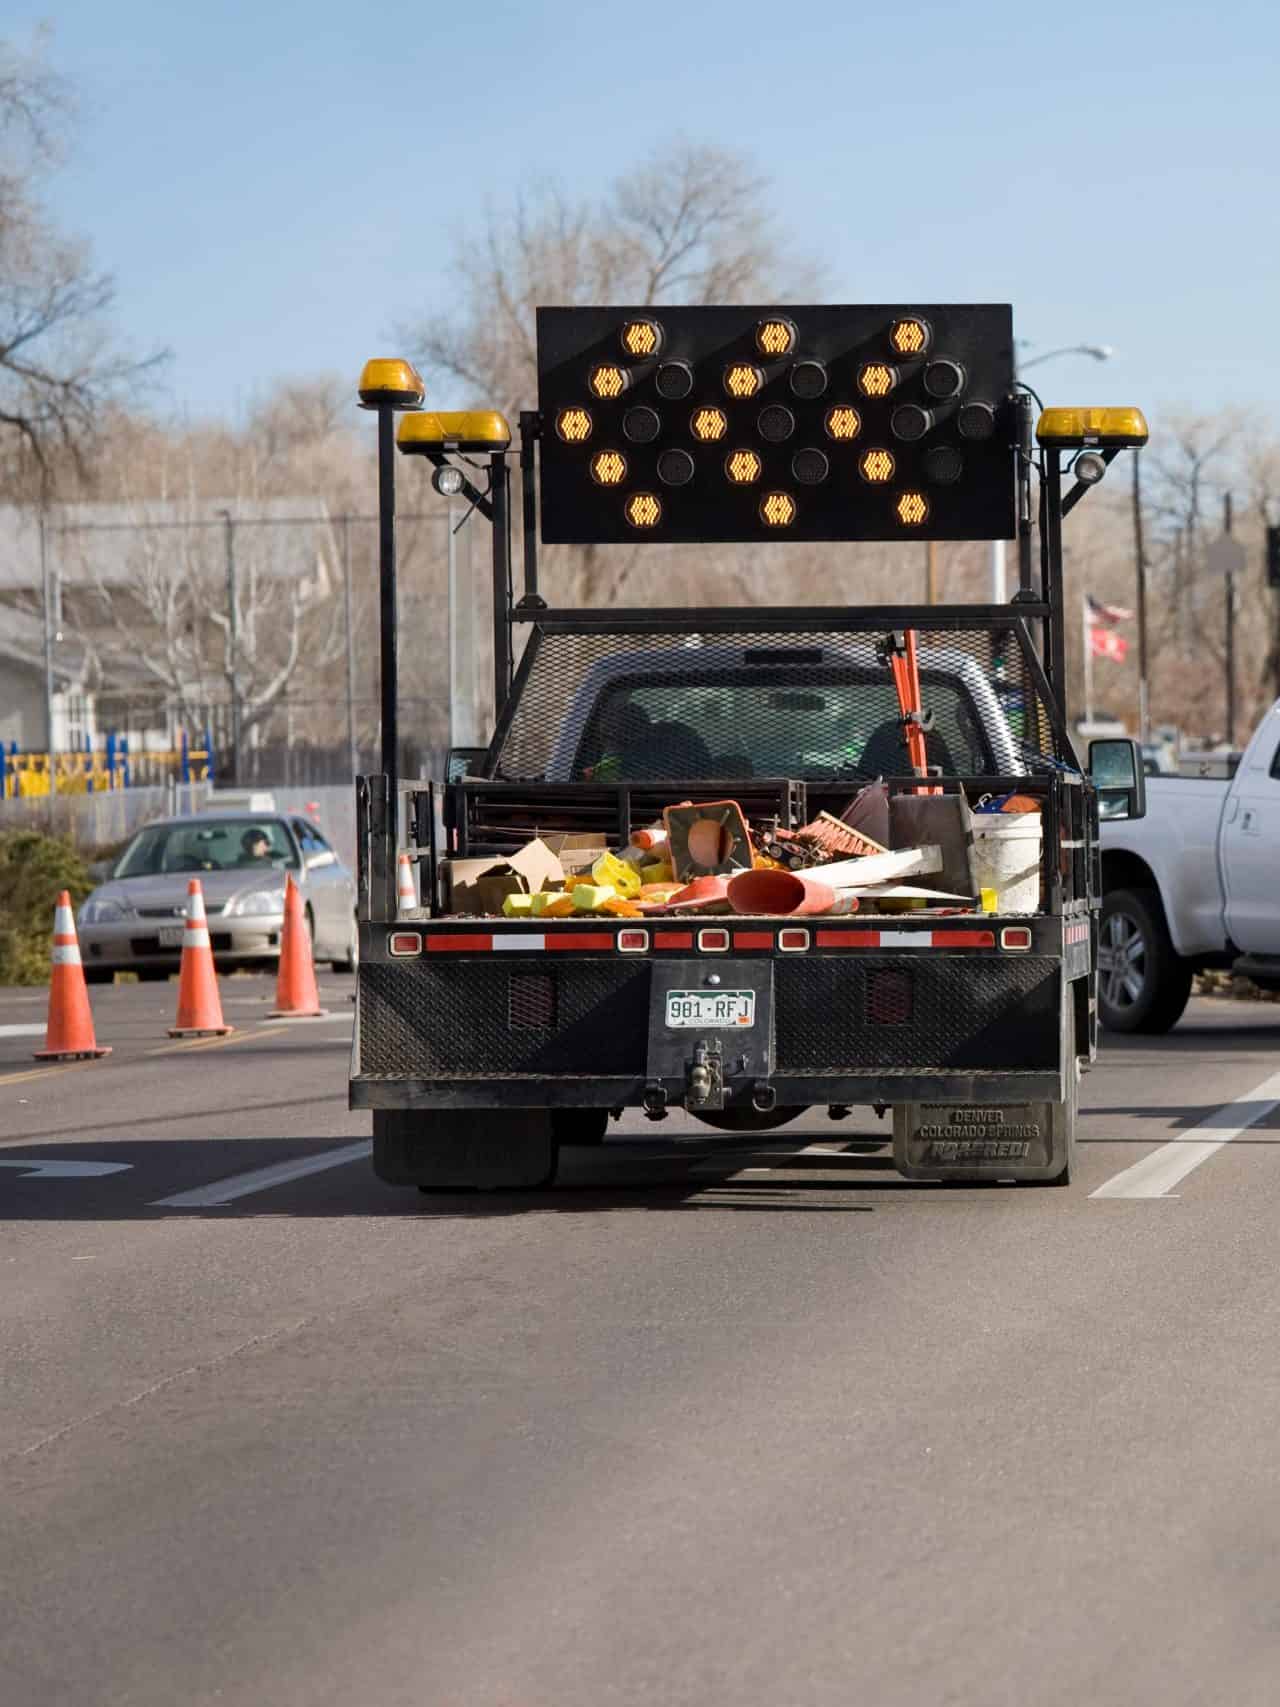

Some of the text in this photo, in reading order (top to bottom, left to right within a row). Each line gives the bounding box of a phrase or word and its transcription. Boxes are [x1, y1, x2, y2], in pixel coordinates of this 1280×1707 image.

[954, 1110, 1004, 1123] DENVER
[919, 1124, 1040, 1137] COLORADO SPRINGS
